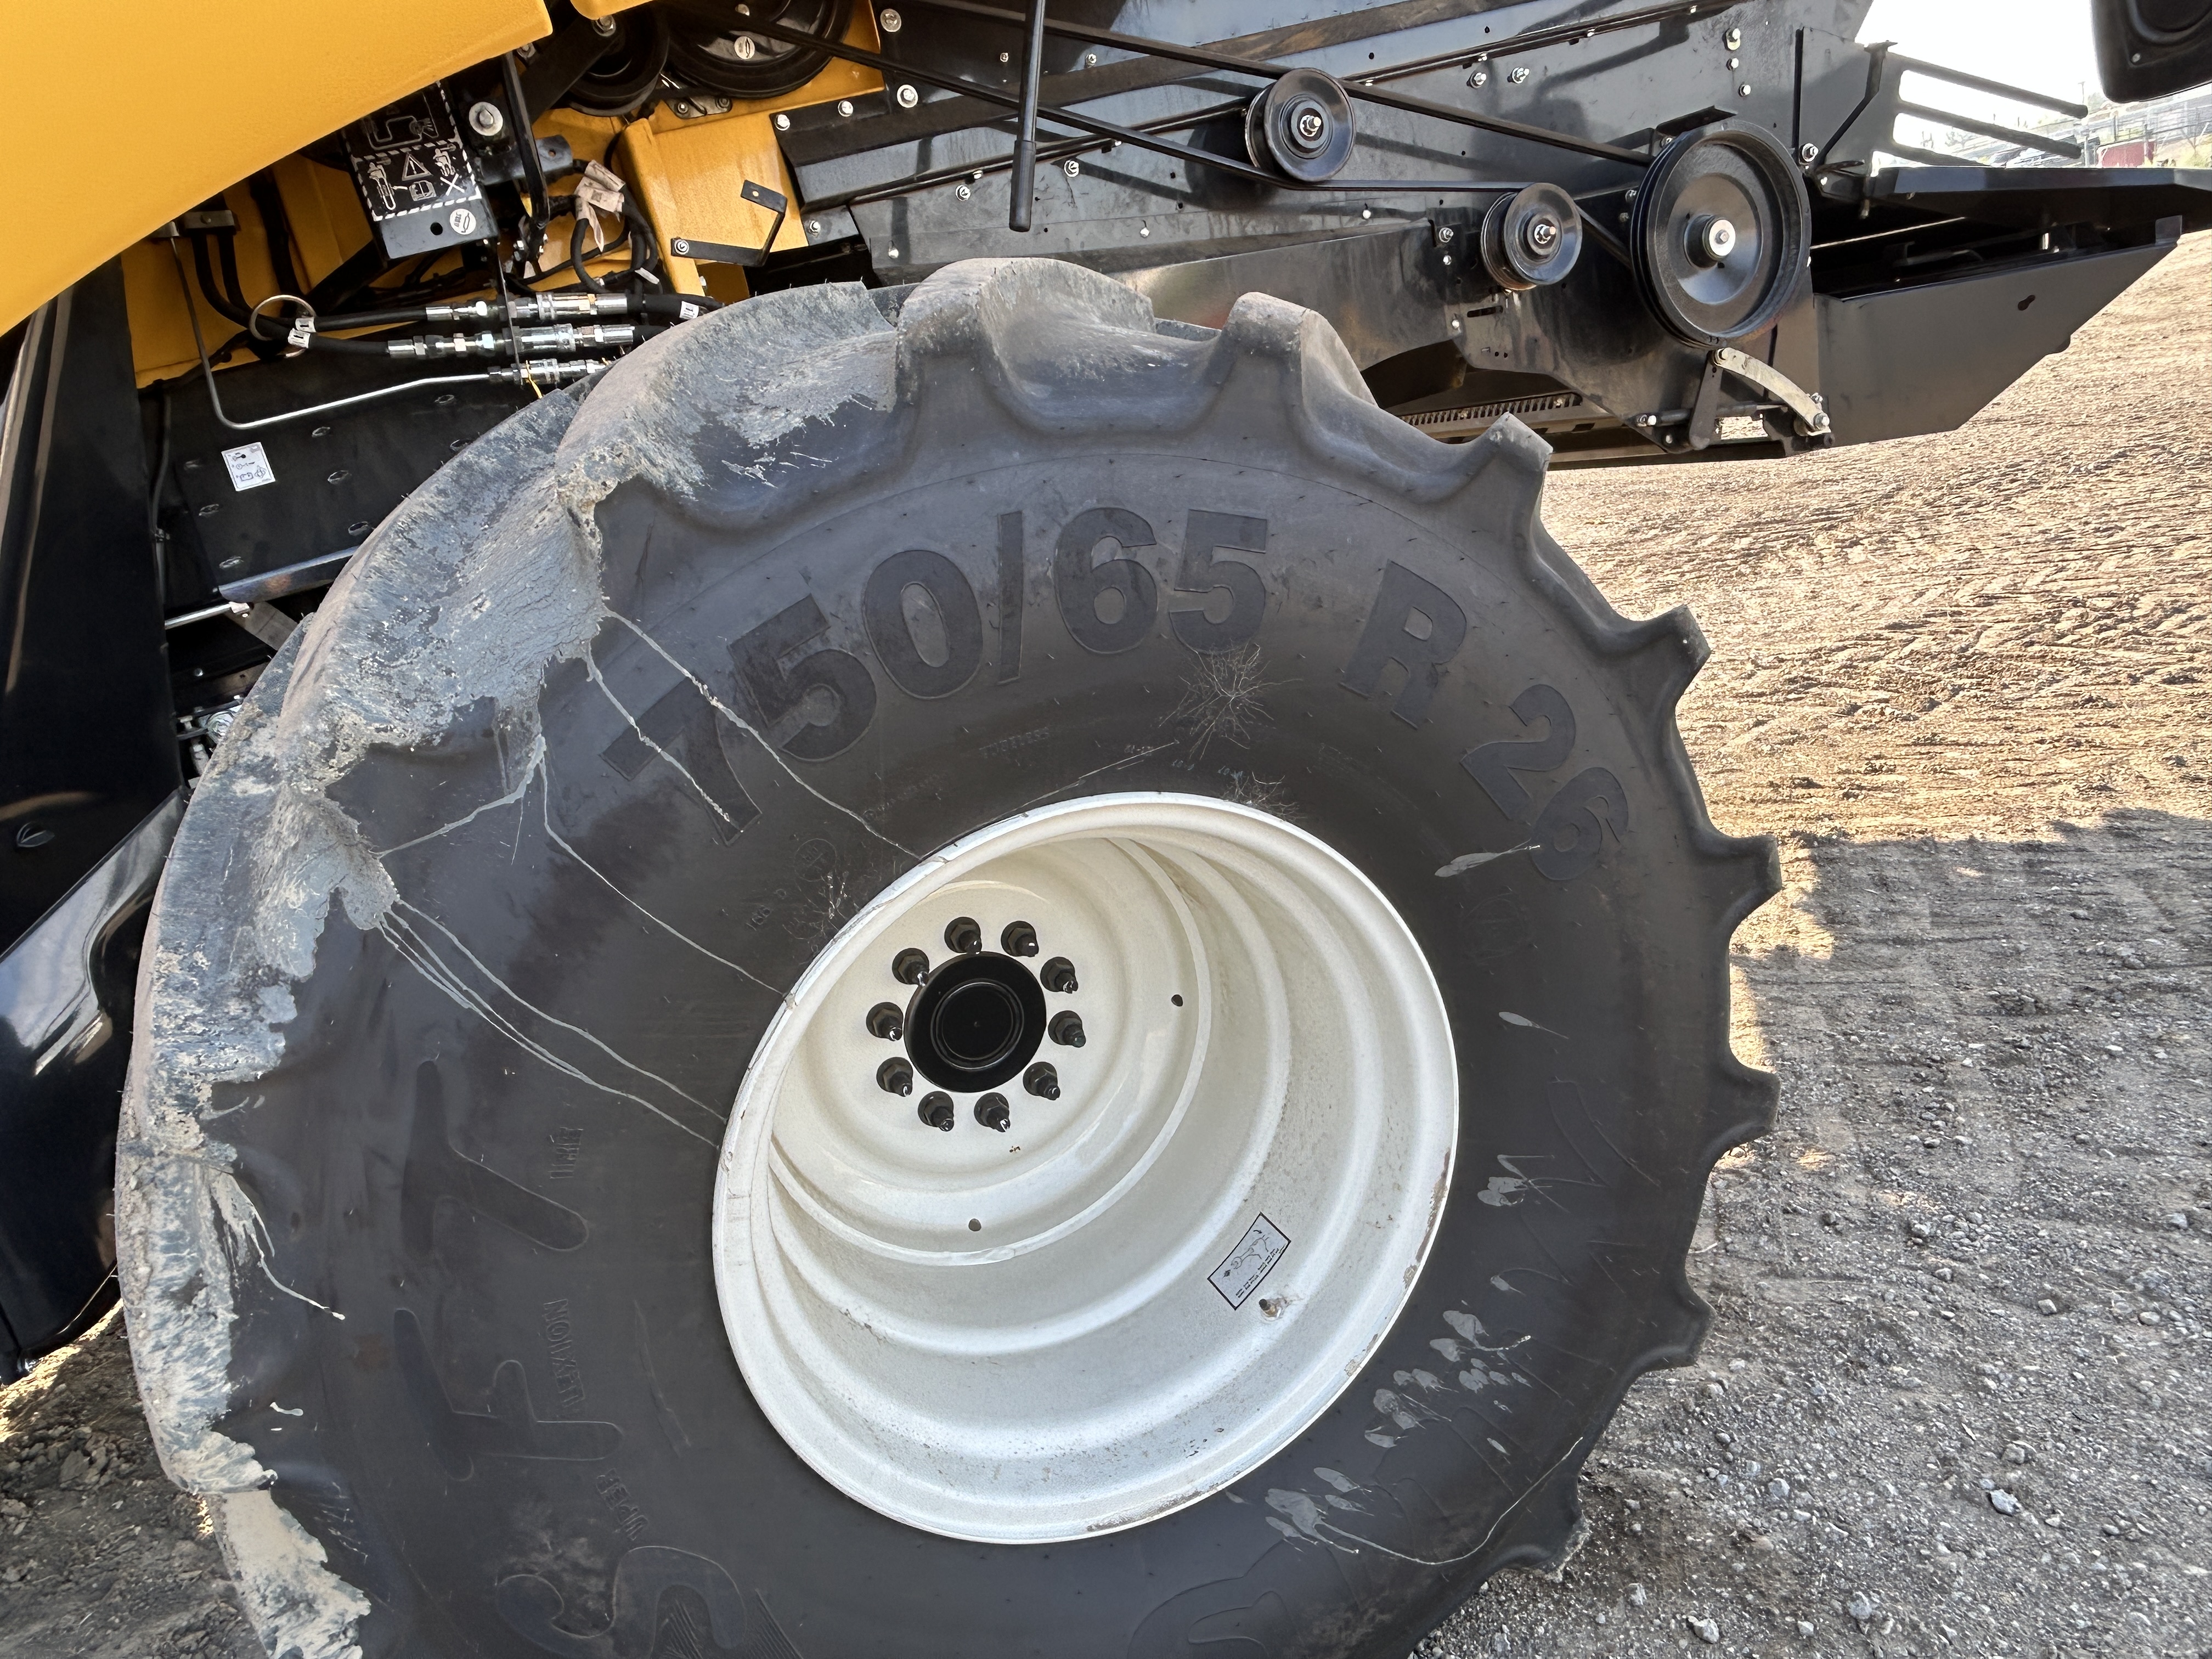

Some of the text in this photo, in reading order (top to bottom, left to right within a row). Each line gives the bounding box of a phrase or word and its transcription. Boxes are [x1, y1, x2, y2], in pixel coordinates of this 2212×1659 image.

[599, 506, 1267, 847] 750/65
[1339, 559, 1466, 730] R
[1460, 684, 1629, 880] 26
